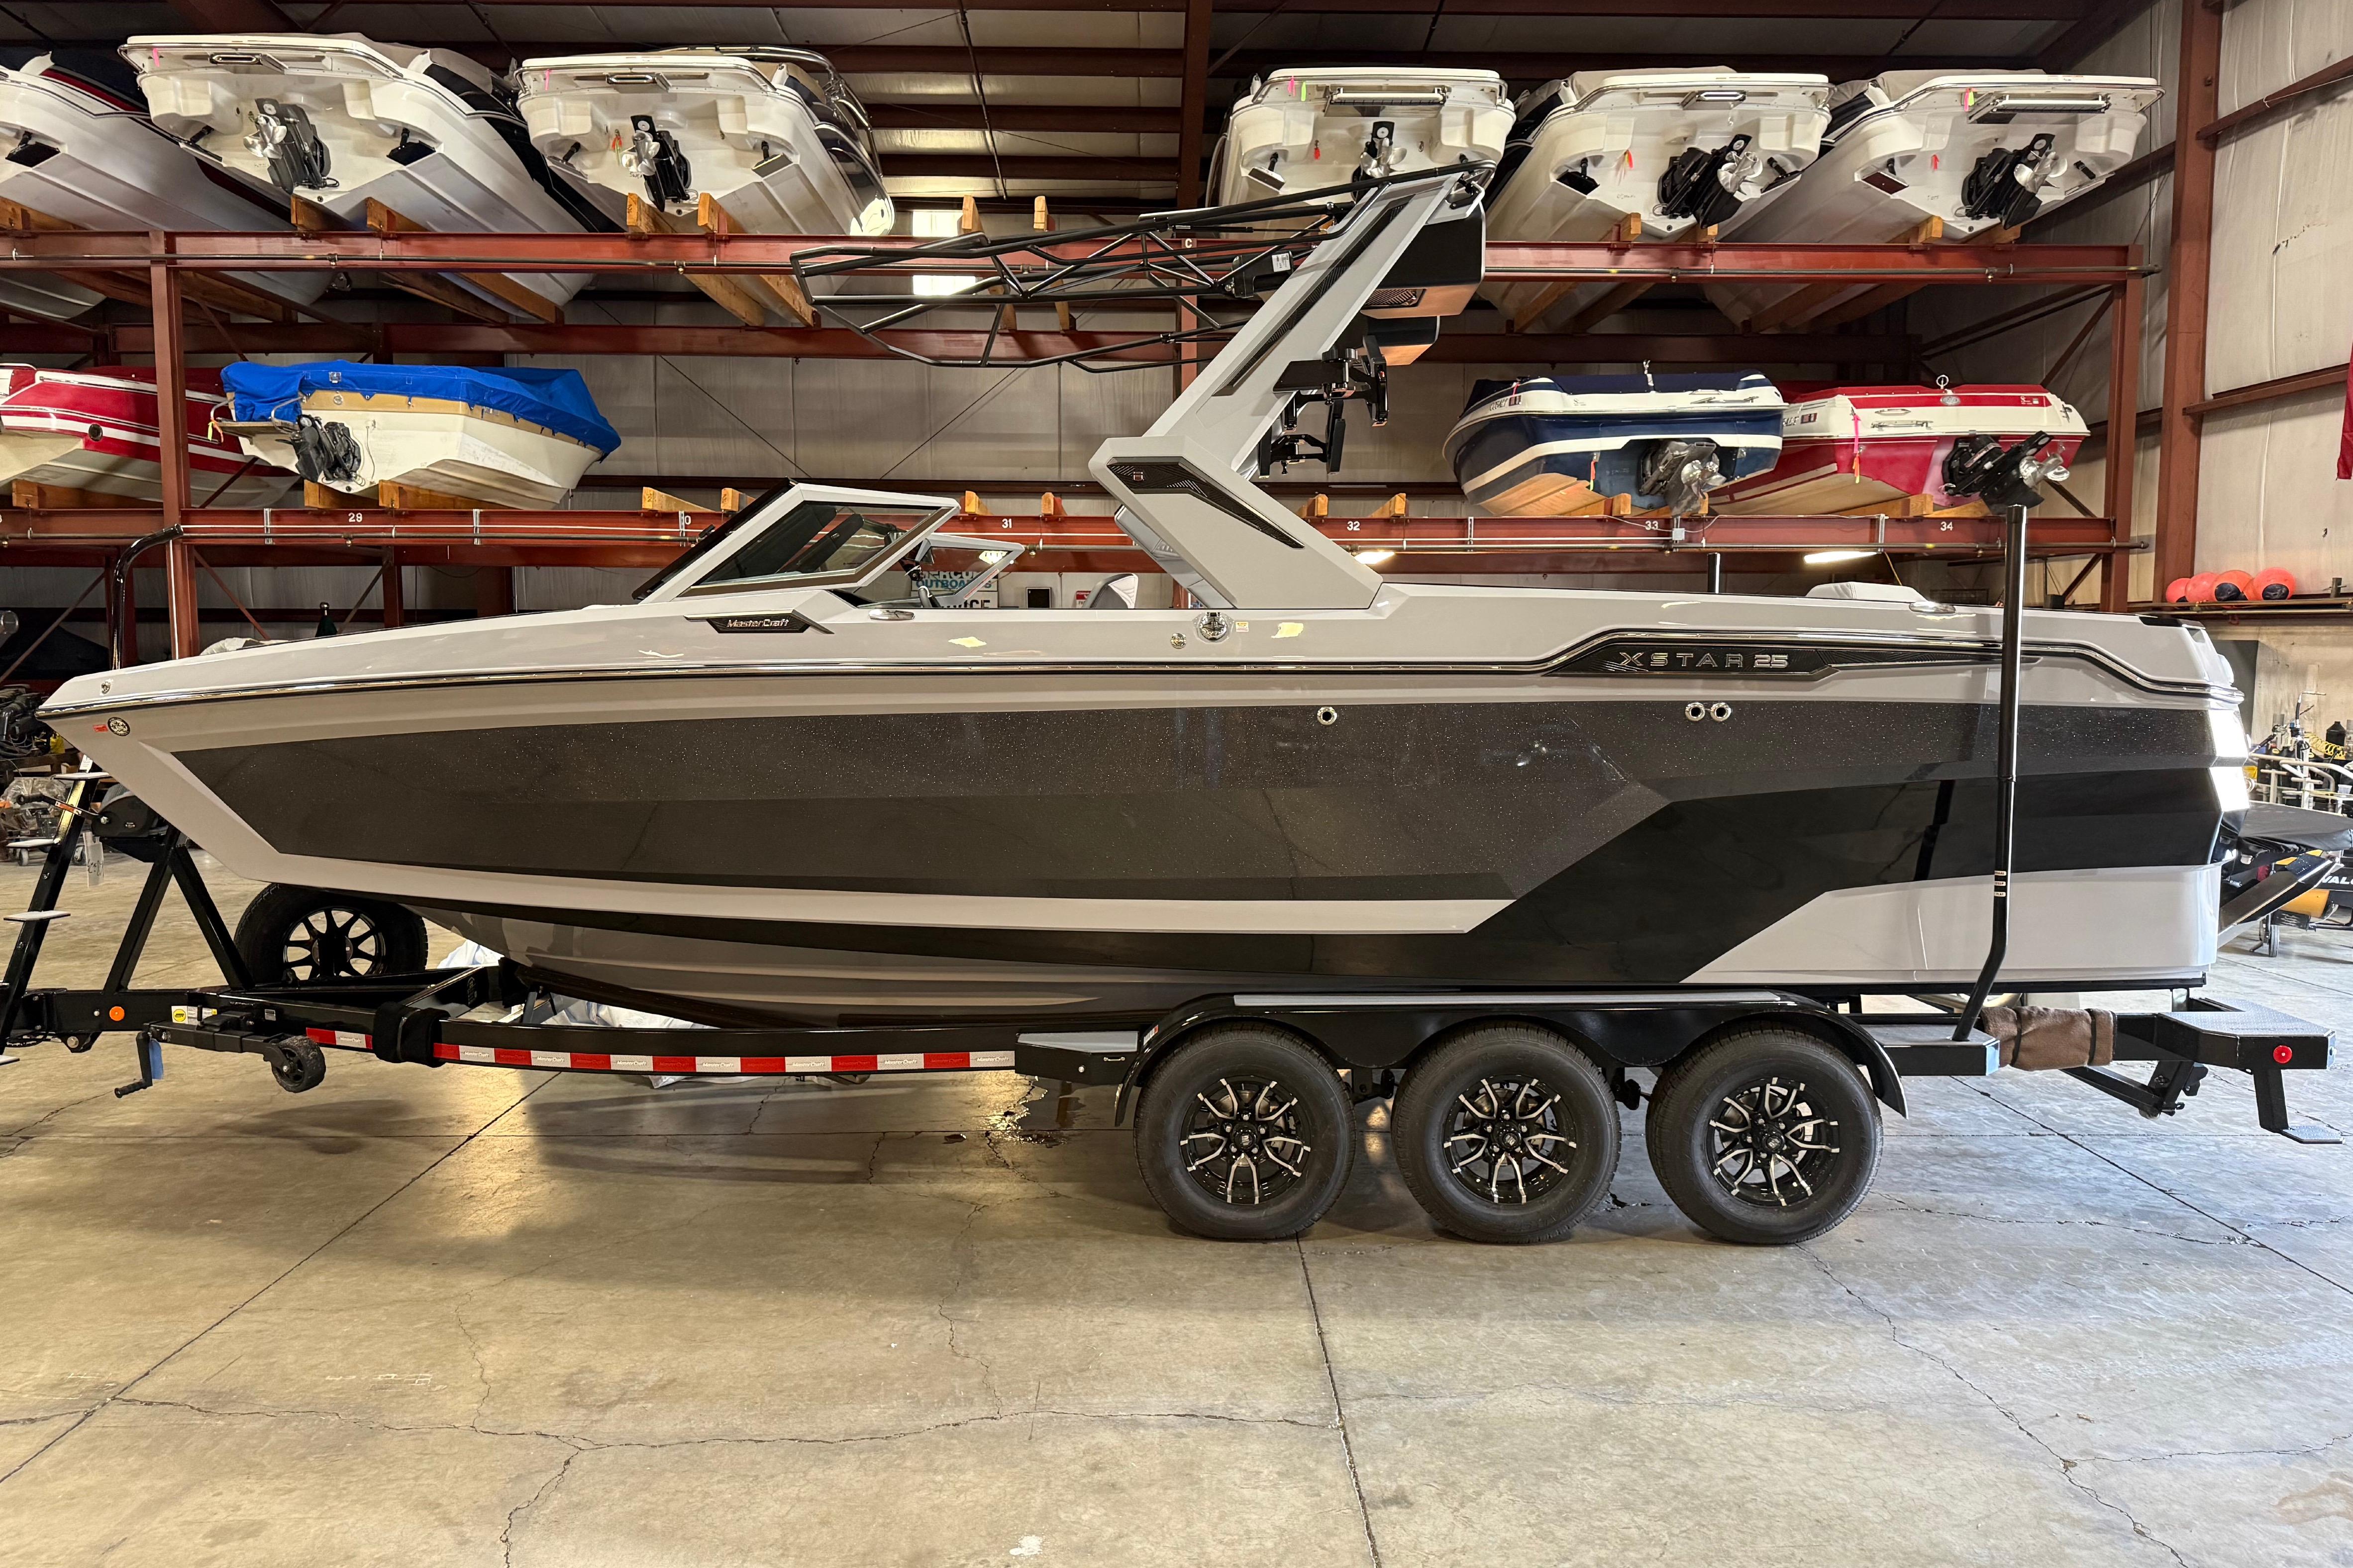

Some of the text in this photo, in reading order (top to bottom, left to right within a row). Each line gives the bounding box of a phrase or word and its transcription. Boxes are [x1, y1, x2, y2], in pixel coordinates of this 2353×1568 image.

[1185, 238, 1192, 248] C
[348, 512, 363, 522] 29
[1002, 518, 1012, 528] 31
[1346, 521, 1360, 531] 32
[1645, 520, 1658, 530] 33
[1941, 521, 1953, 531] 34
[726, 618, 789, 627] MasterCraft
[1753, 654, 1789, 668] 25
